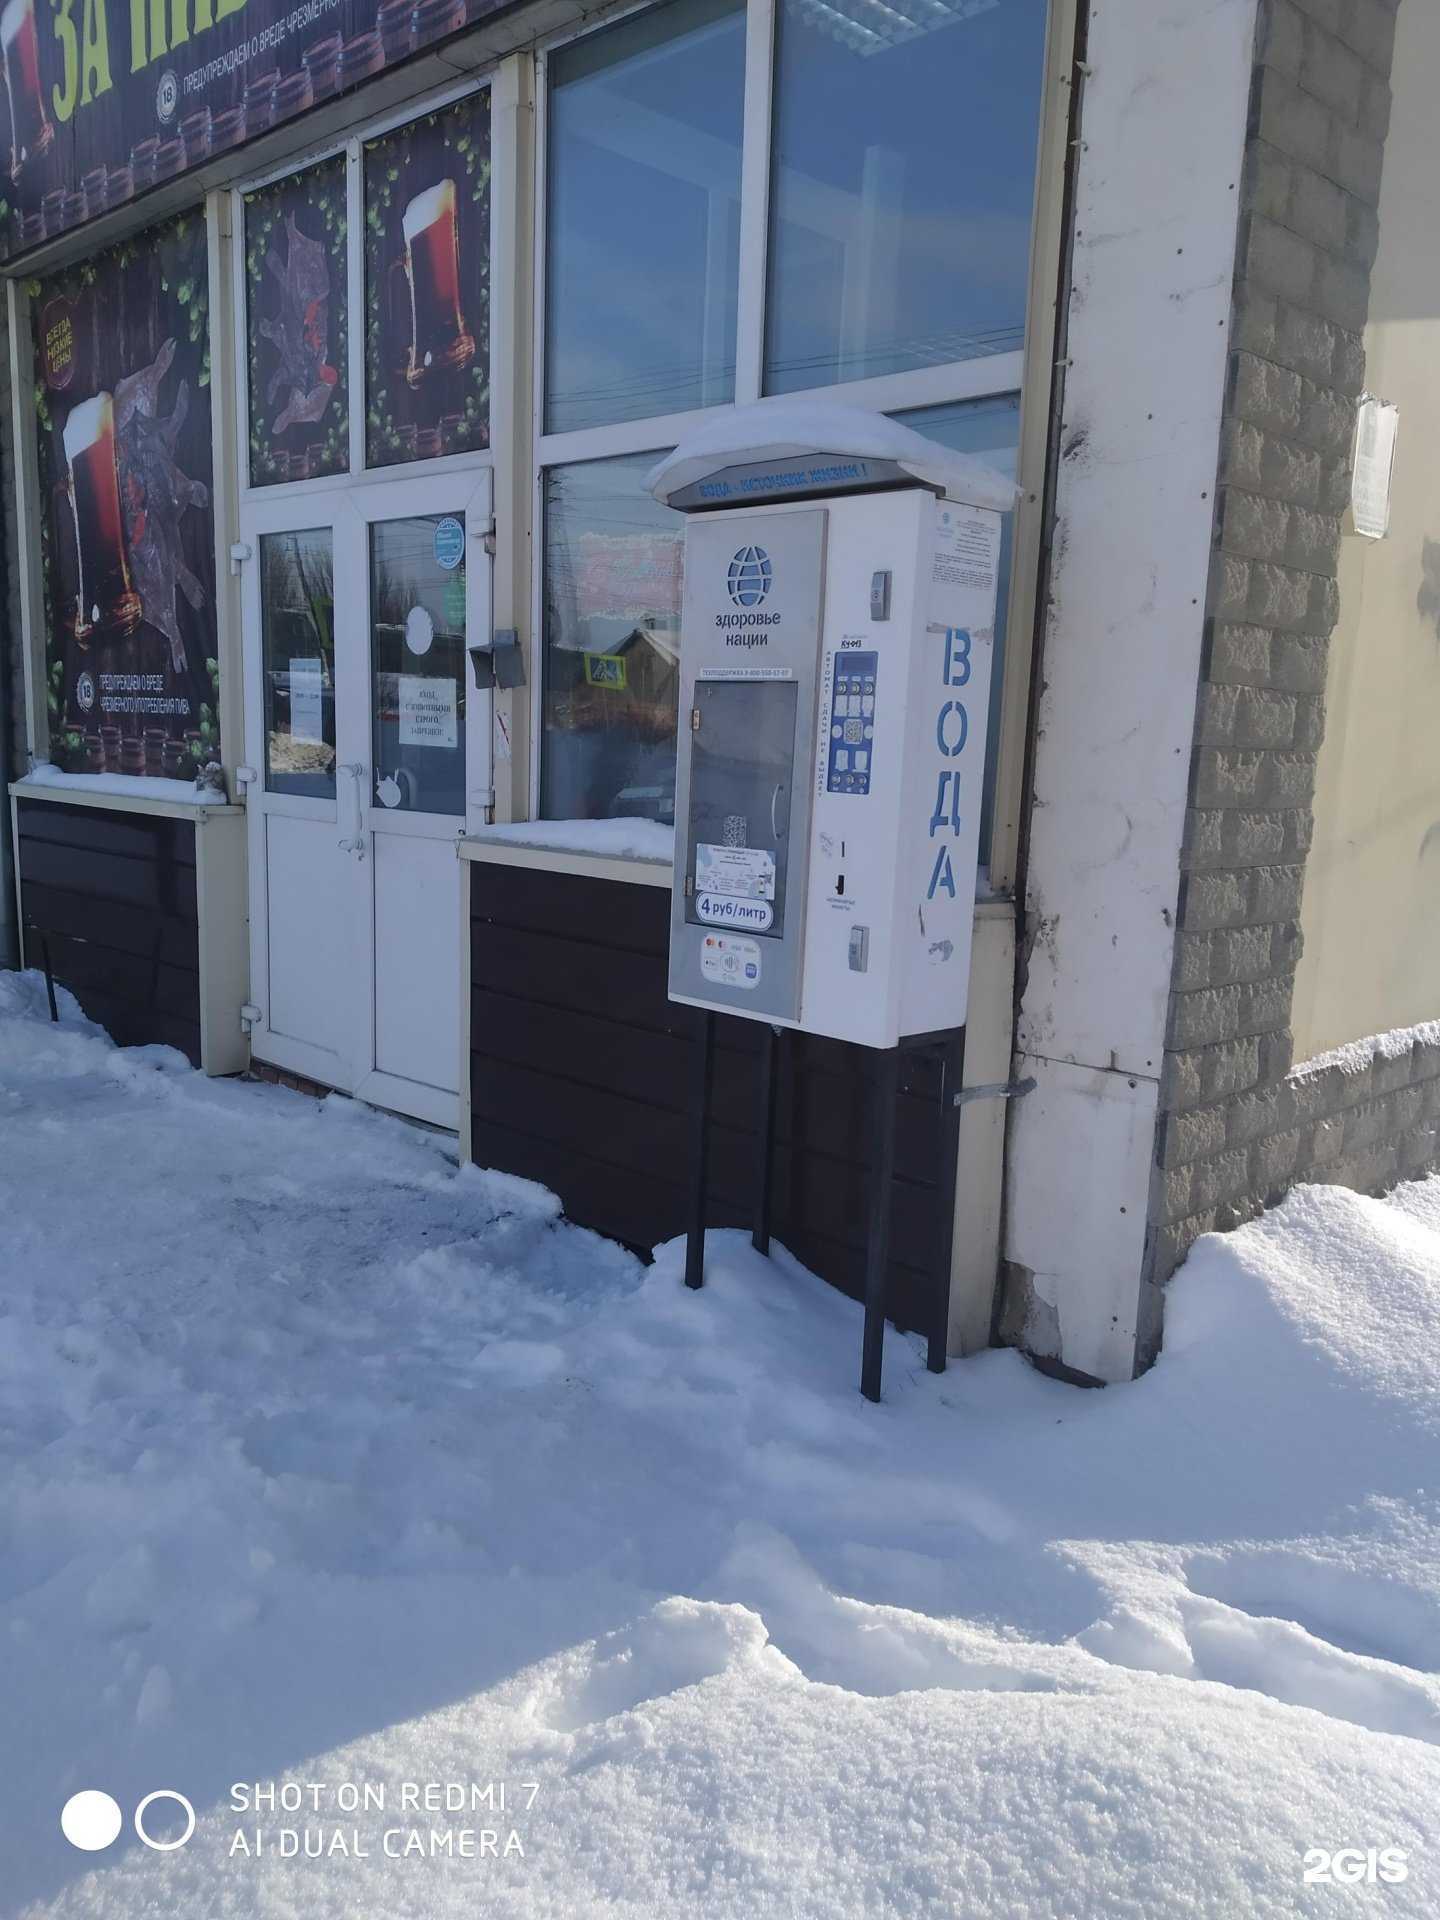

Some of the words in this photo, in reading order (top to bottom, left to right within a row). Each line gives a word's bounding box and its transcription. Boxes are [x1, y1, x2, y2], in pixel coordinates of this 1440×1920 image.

[183, 44, 250, 94] ПРЕДУПРЕЖДАЕМ
[251, 41, 258, 57] О
[259, 19, 286, 51] ВРЕДЕ
[715, 612, 781, 629] здоровье
[726, 633, 768, 649] нации
[928, 627, 971, 899] ВОДА
[701, 898, 711, 914] 4
[712, 902, 767, 922] руб/литр
